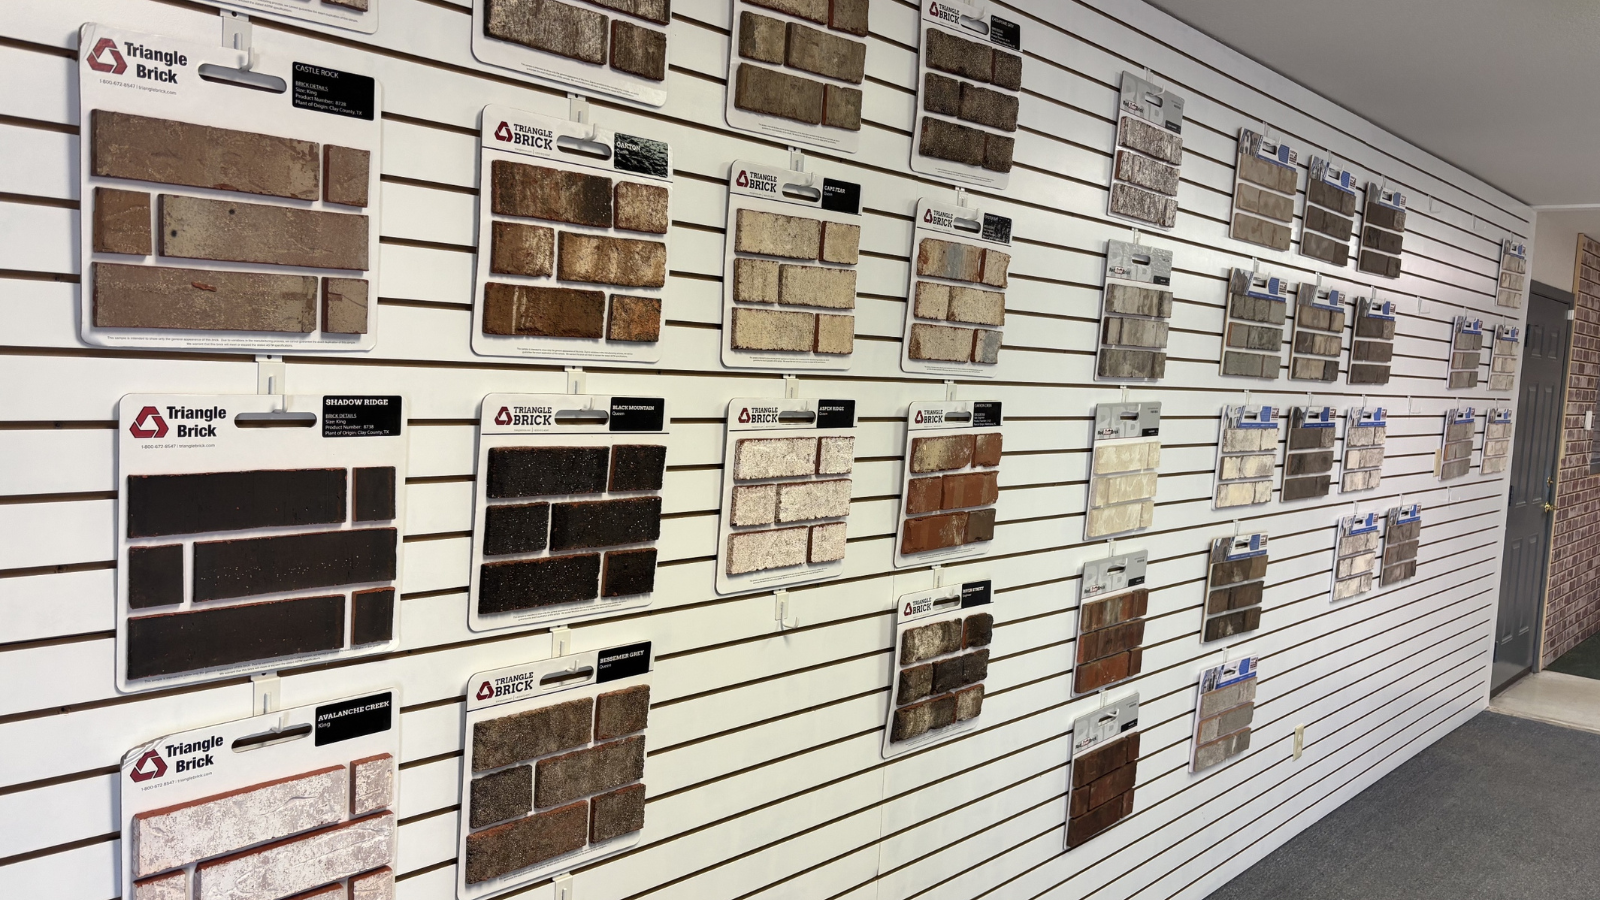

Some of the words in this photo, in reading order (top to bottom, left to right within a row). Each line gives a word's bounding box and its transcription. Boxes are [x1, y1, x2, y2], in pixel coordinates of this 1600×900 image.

[939, 10, 960, 25] BRICK
[124, 42, 188, 66] Triangle
[136, 63, 178, 84] Brick
[295, 65, 320, 75] CASTLE
[321, 70, 339, 79] ROCK
[513, 123, 553, 138] TRIANGLE
[513, 132, 553, 151] BRICK
[750, 171, 777, 182] TRIANGLE
[749, 179, 777, 193] BRICK
[932, 216, 953, 228] BRICK
[325, 398, 363, 406] SHADOW
[364, 398, 389, 406] RIDGE
[166, 405, 227, 422] Triangle
[513, 406, 552, 414] TRIANGLE
[513, 415, 552, 426] BRICK
[751, 414, 778, 424] BRICK
[923, 416, 943, 424] BRICK
[177, 424, 217, 438] Brick
[912, 603, 932, 615] BRICK
[629, 650, 645, 658] GREY
[495, 672, 534, 686] TRIANGLE
[494, 680, 534, 698] BRICK
[318, 707, 365, 721] AVALANCHE
[365, 700, 390, 711] CREEK
[165, 735, 224, 758] Triangle
[176, 754, 215, 773] Brick
